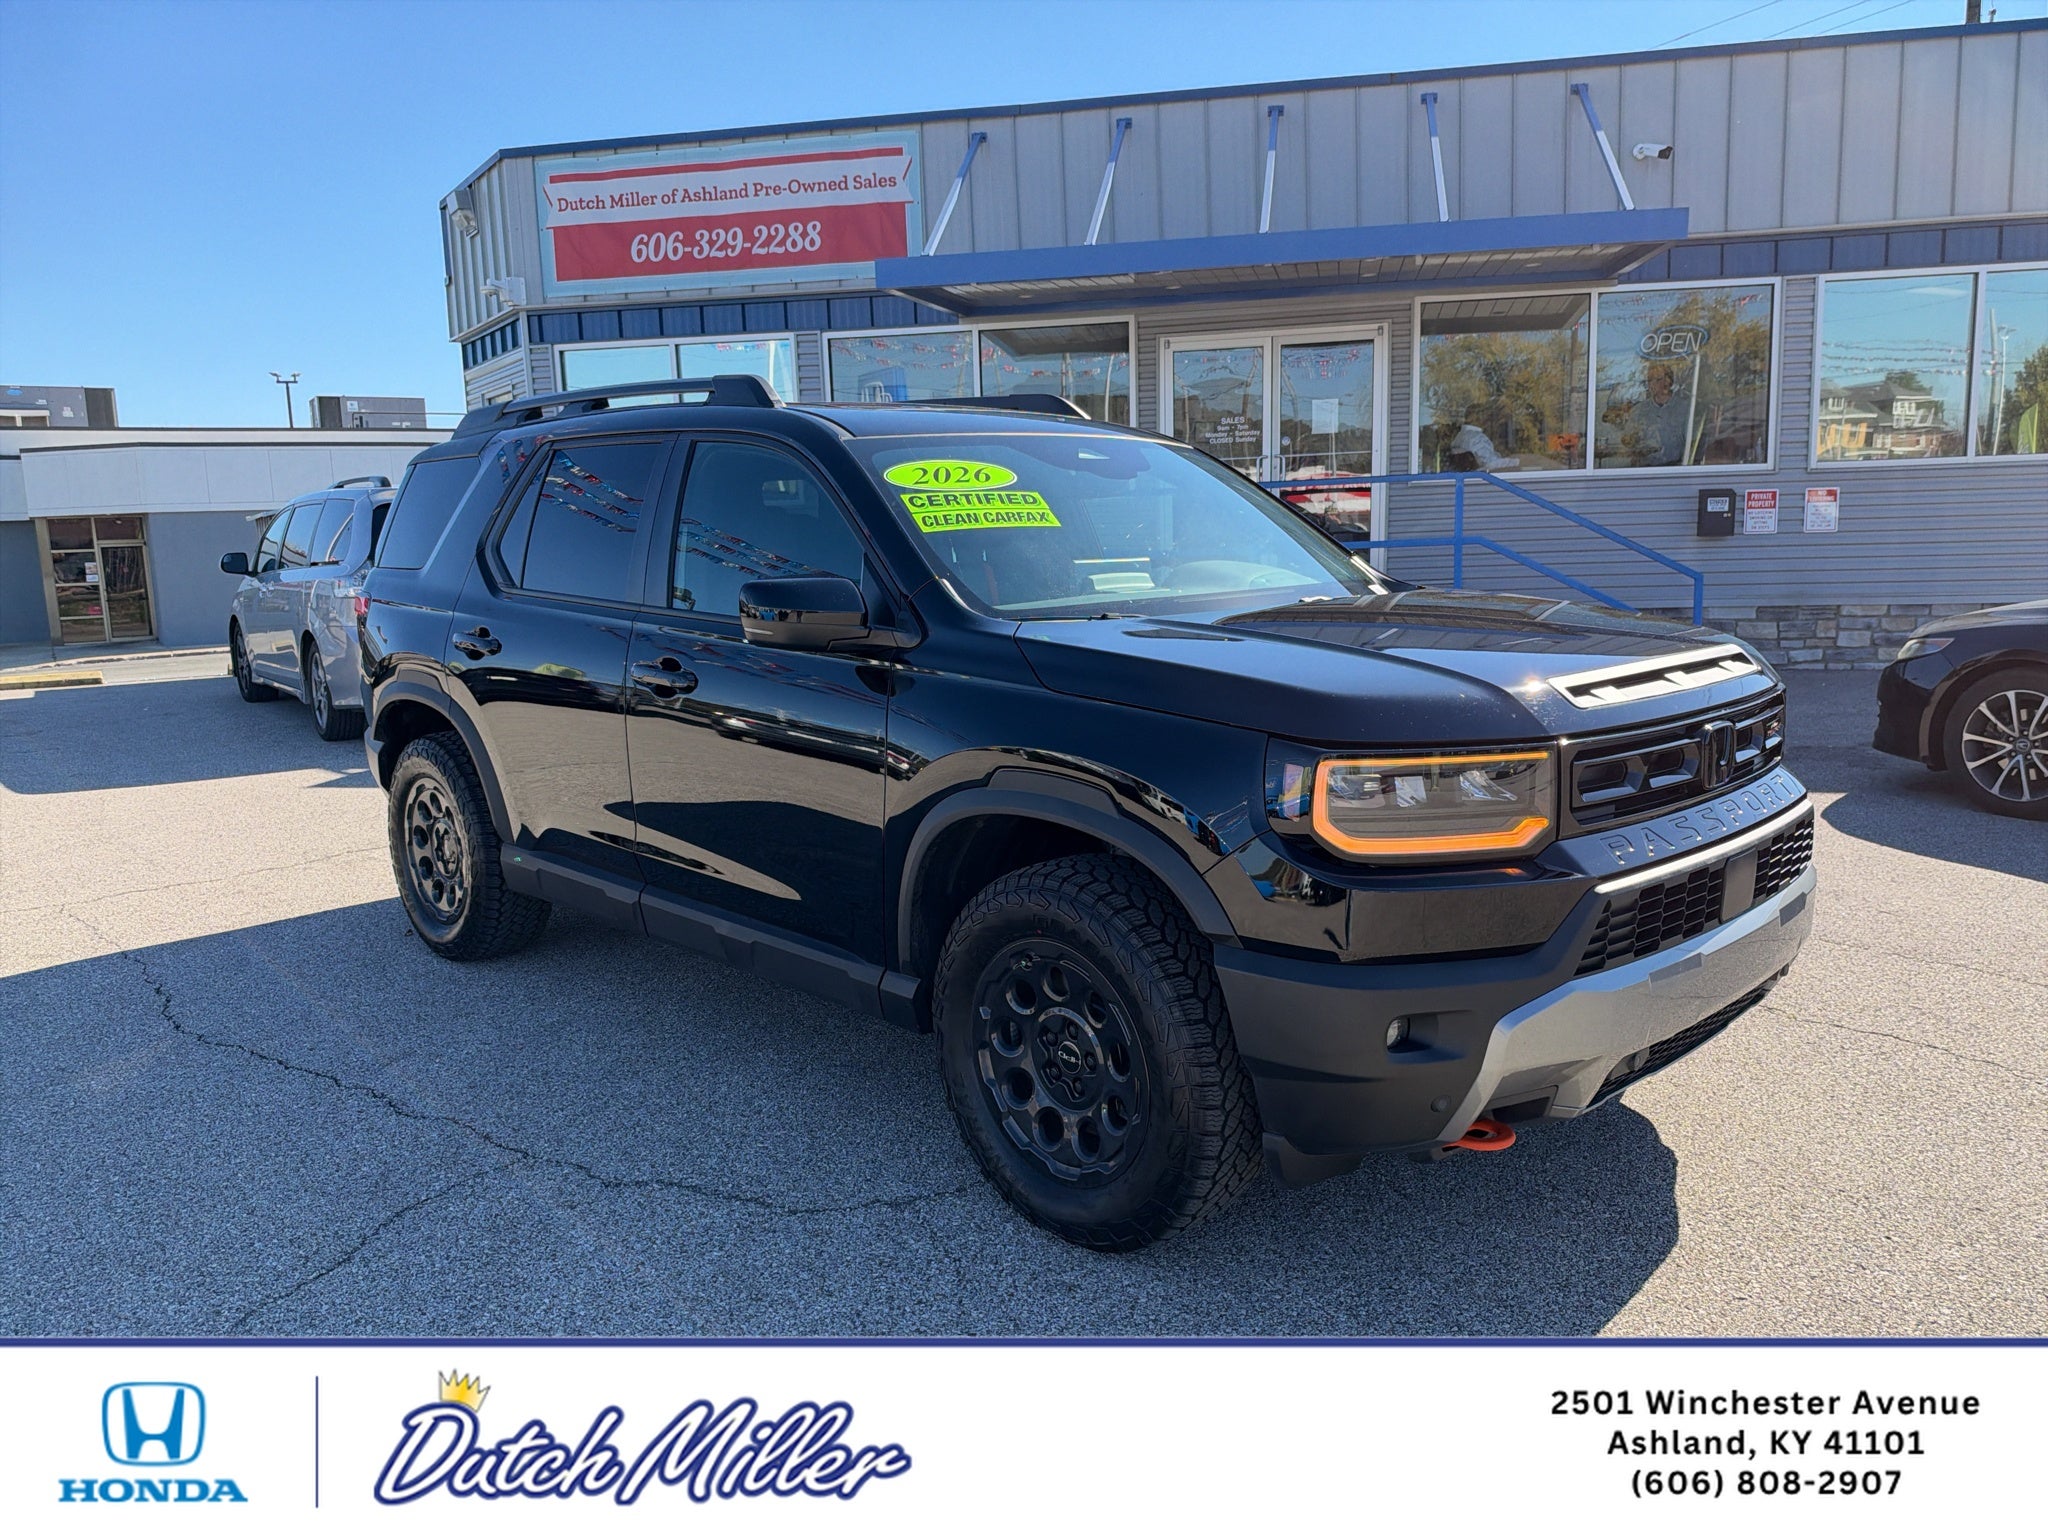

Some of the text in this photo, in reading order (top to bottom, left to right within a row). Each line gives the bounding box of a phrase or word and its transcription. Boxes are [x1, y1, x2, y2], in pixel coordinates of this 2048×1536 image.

[557, 172, 897, 213] Dutch Miller of Ashland Pre-Owned Sales
[630, 220, 822, 264] 606-329-2288
[1640, 332, 1702, 353] OPEN
[1221, 416, 1245, 424] SALES
[911, 466, 991, 485] 2026
[907, 493, 1040, 509] CERTIFIED
[1748, 500, 1775, 508] PROPERTY
[921, 511, 1051, 528] CLEAN CARFAX
[1600, 774, 1795, 864] PASSPORT
